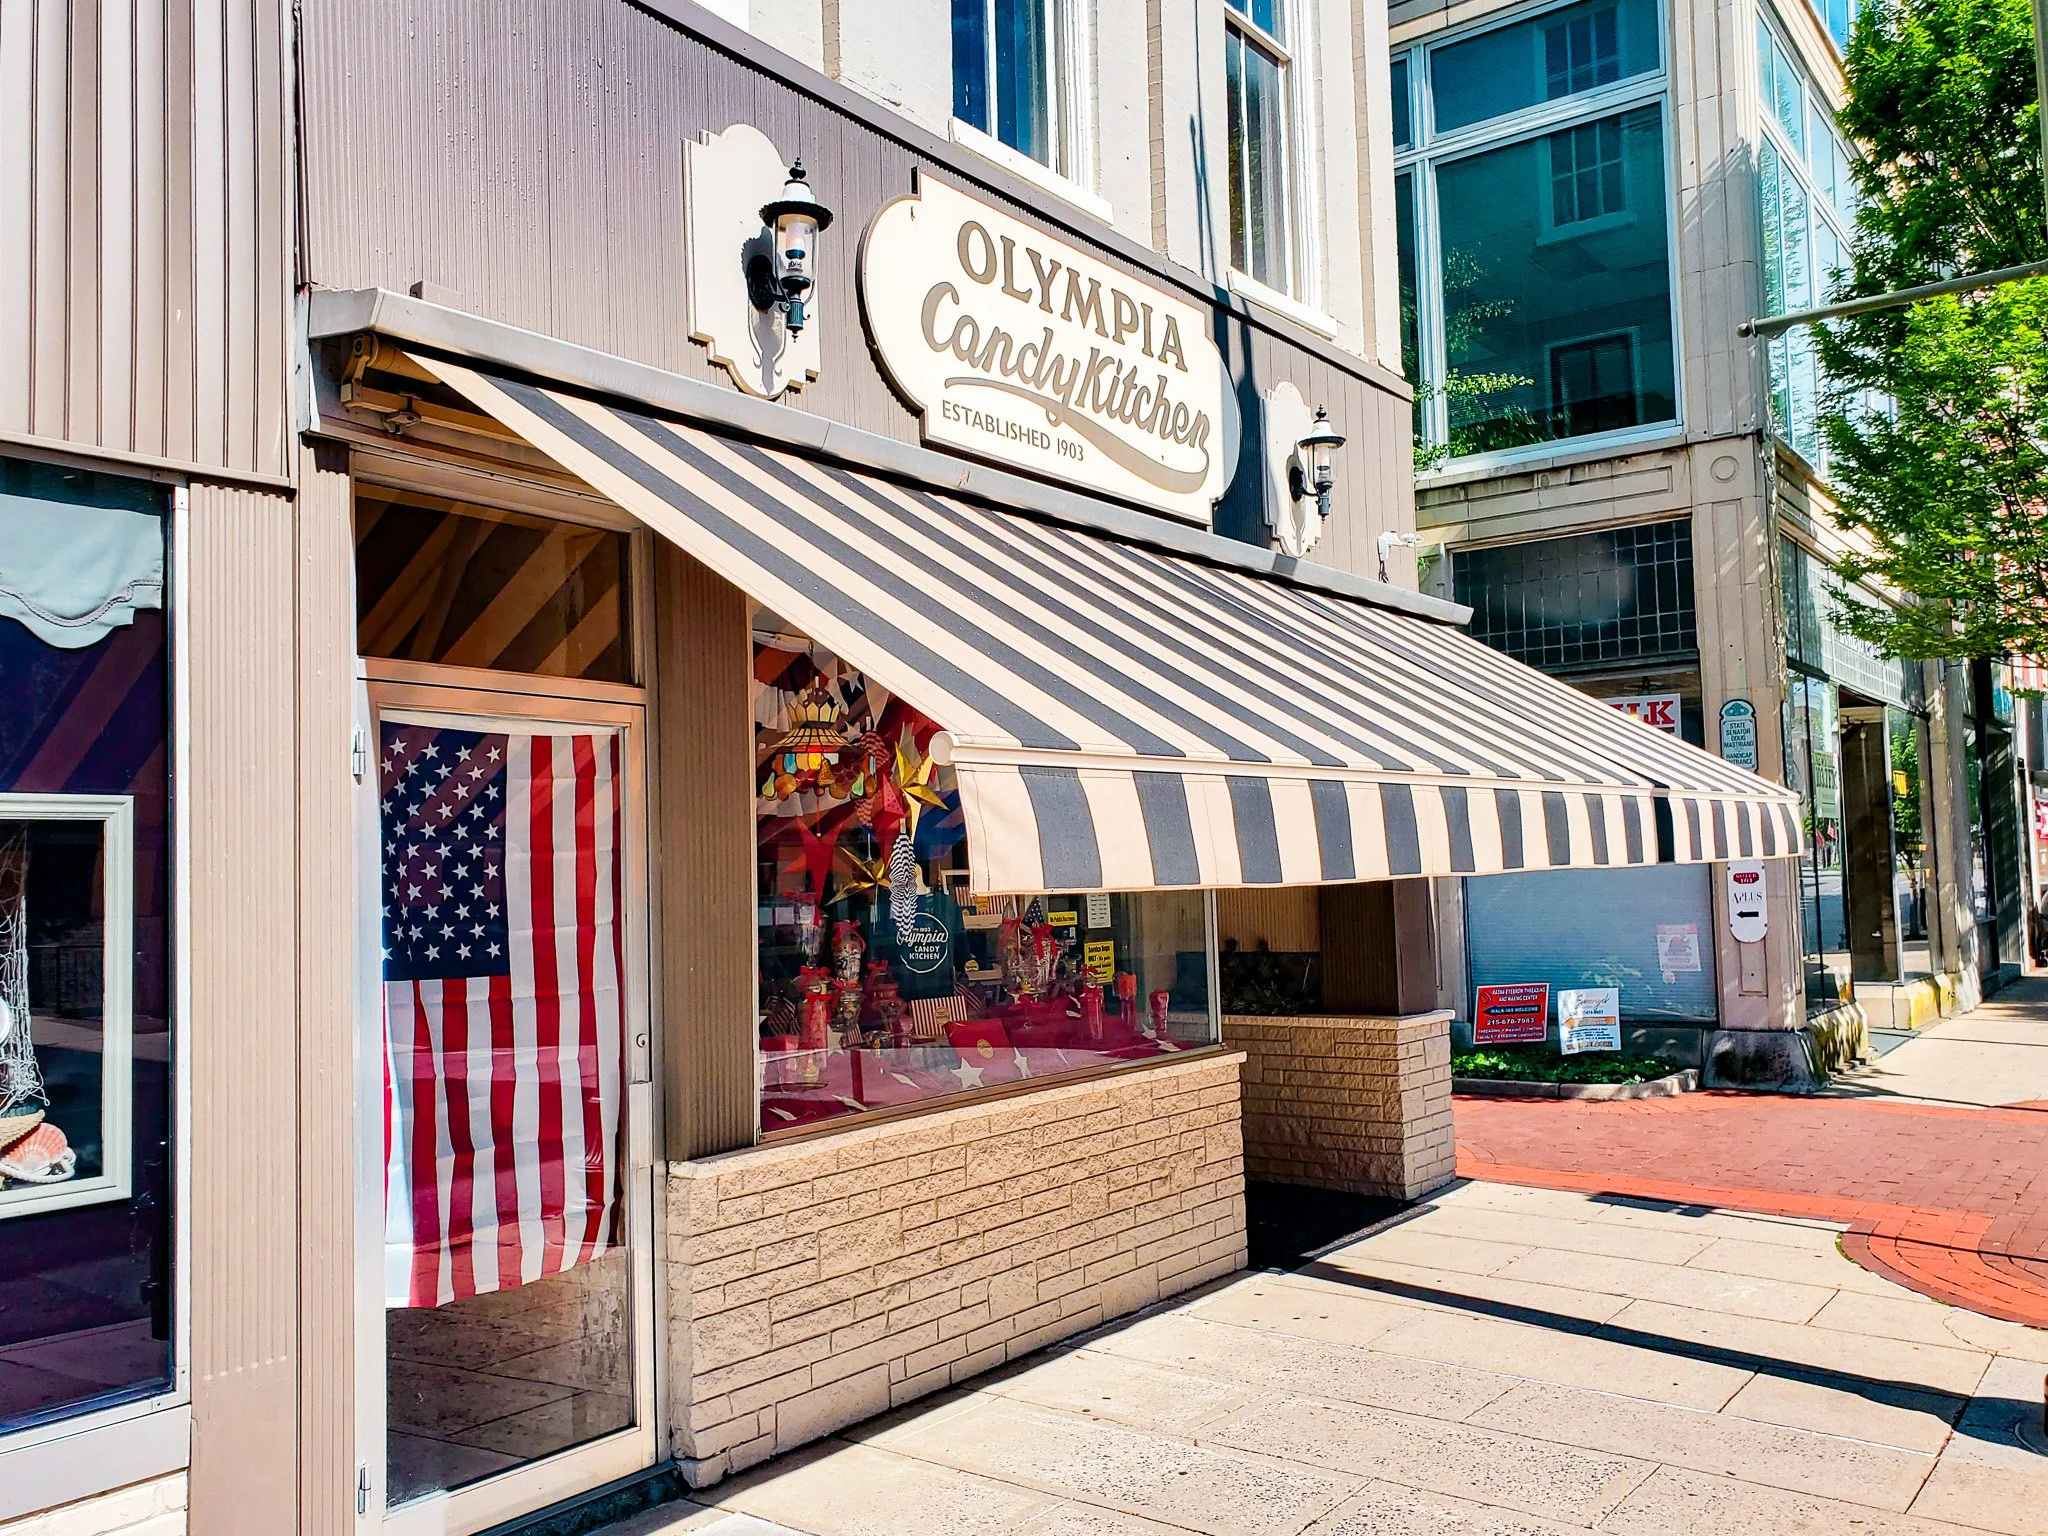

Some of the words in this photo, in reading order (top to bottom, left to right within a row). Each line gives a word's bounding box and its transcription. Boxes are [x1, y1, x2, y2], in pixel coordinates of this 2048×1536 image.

[957, 220, 1188, 372] OLYMPIA
[921, 282, 1080, 427] Candy
[1075, 347, 1211, 449] Kitchen
[942, 400, 1051, 450] ESTABLISHED
[1056, 438, 1085, 462] 1903
[909, 952, 940, 960] KITCHEN
